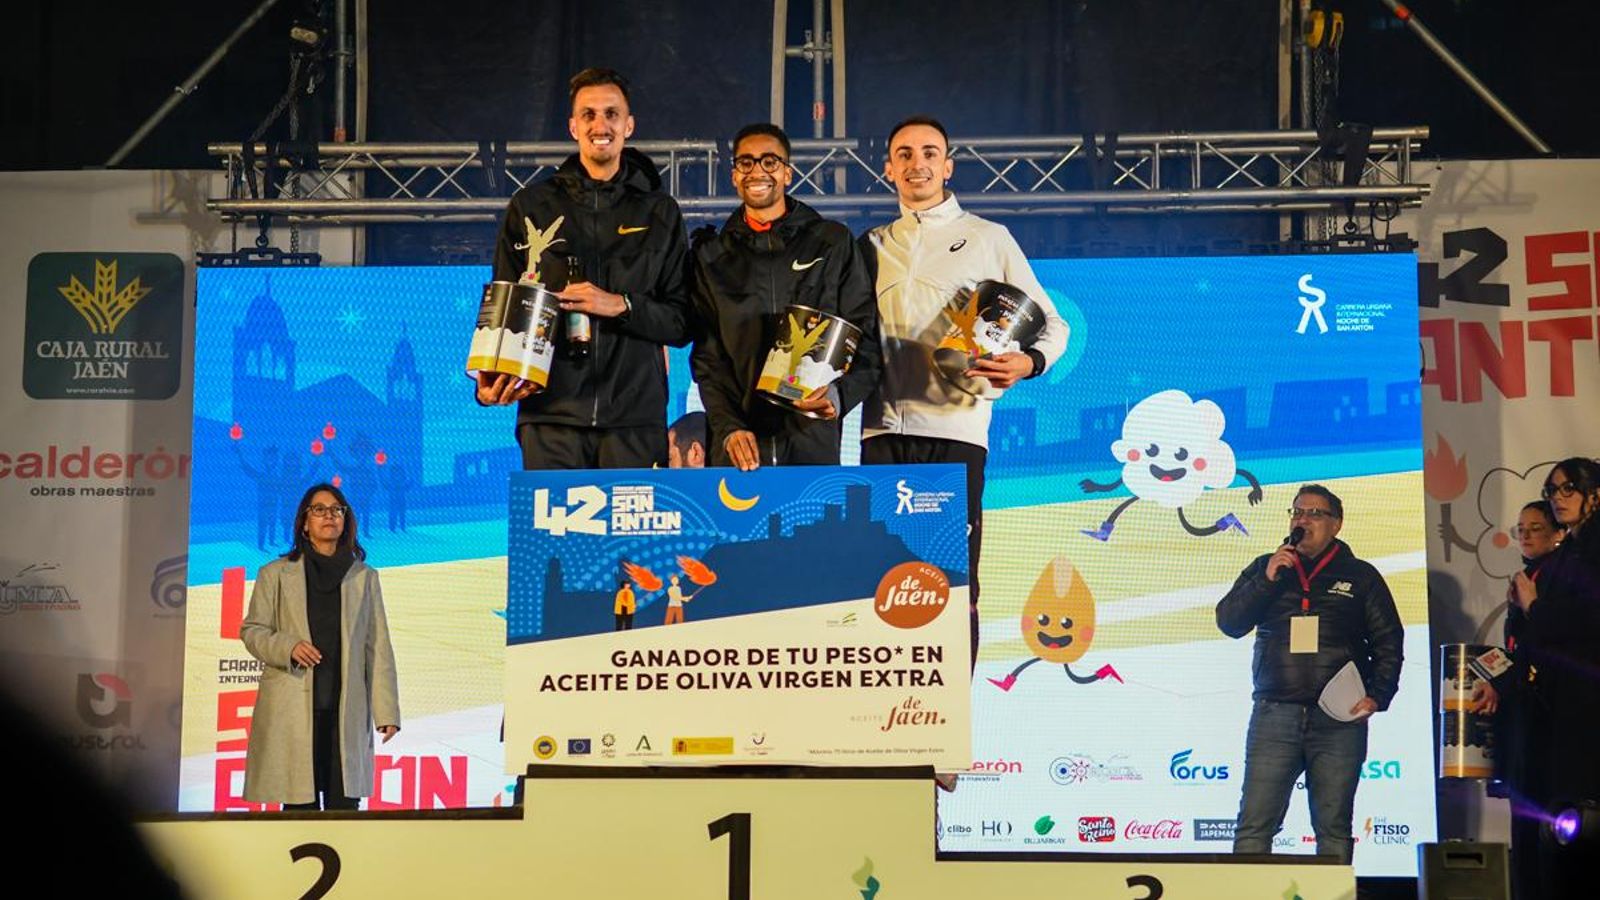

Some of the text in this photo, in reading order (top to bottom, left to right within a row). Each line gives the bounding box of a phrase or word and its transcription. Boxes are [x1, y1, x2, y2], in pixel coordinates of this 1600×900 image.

[36, 340, 169, 360] CAJA RURAL
[1419, 315, 1600, 404] ANT
[73, 358, 129, 380] JAÉN
[30, 485, 156, 497] obras maestras
[534, 485, 607, 536] 42
[611, 494, 654, 512] SAN
[900, 575, 919, 590] de
[611, 648, 740, 668] GANADOR
[747, 648, 780, 666] DE
[786, 647, 818, 665] TU
[912, 645, 943, 663] EN
[540, 668, 944, 692] ACEITE DE OLIVA VIRGEN EXTRA
[902, 696, 921, 710] de
[947, 824, 972, 833] clibo
[1374, 825, 1410, 834] FISIO
[1374, 837, 1410, 845] CLINIC
[707, 812, 751, 900] 1
[289, 843, 341, 900] 2
